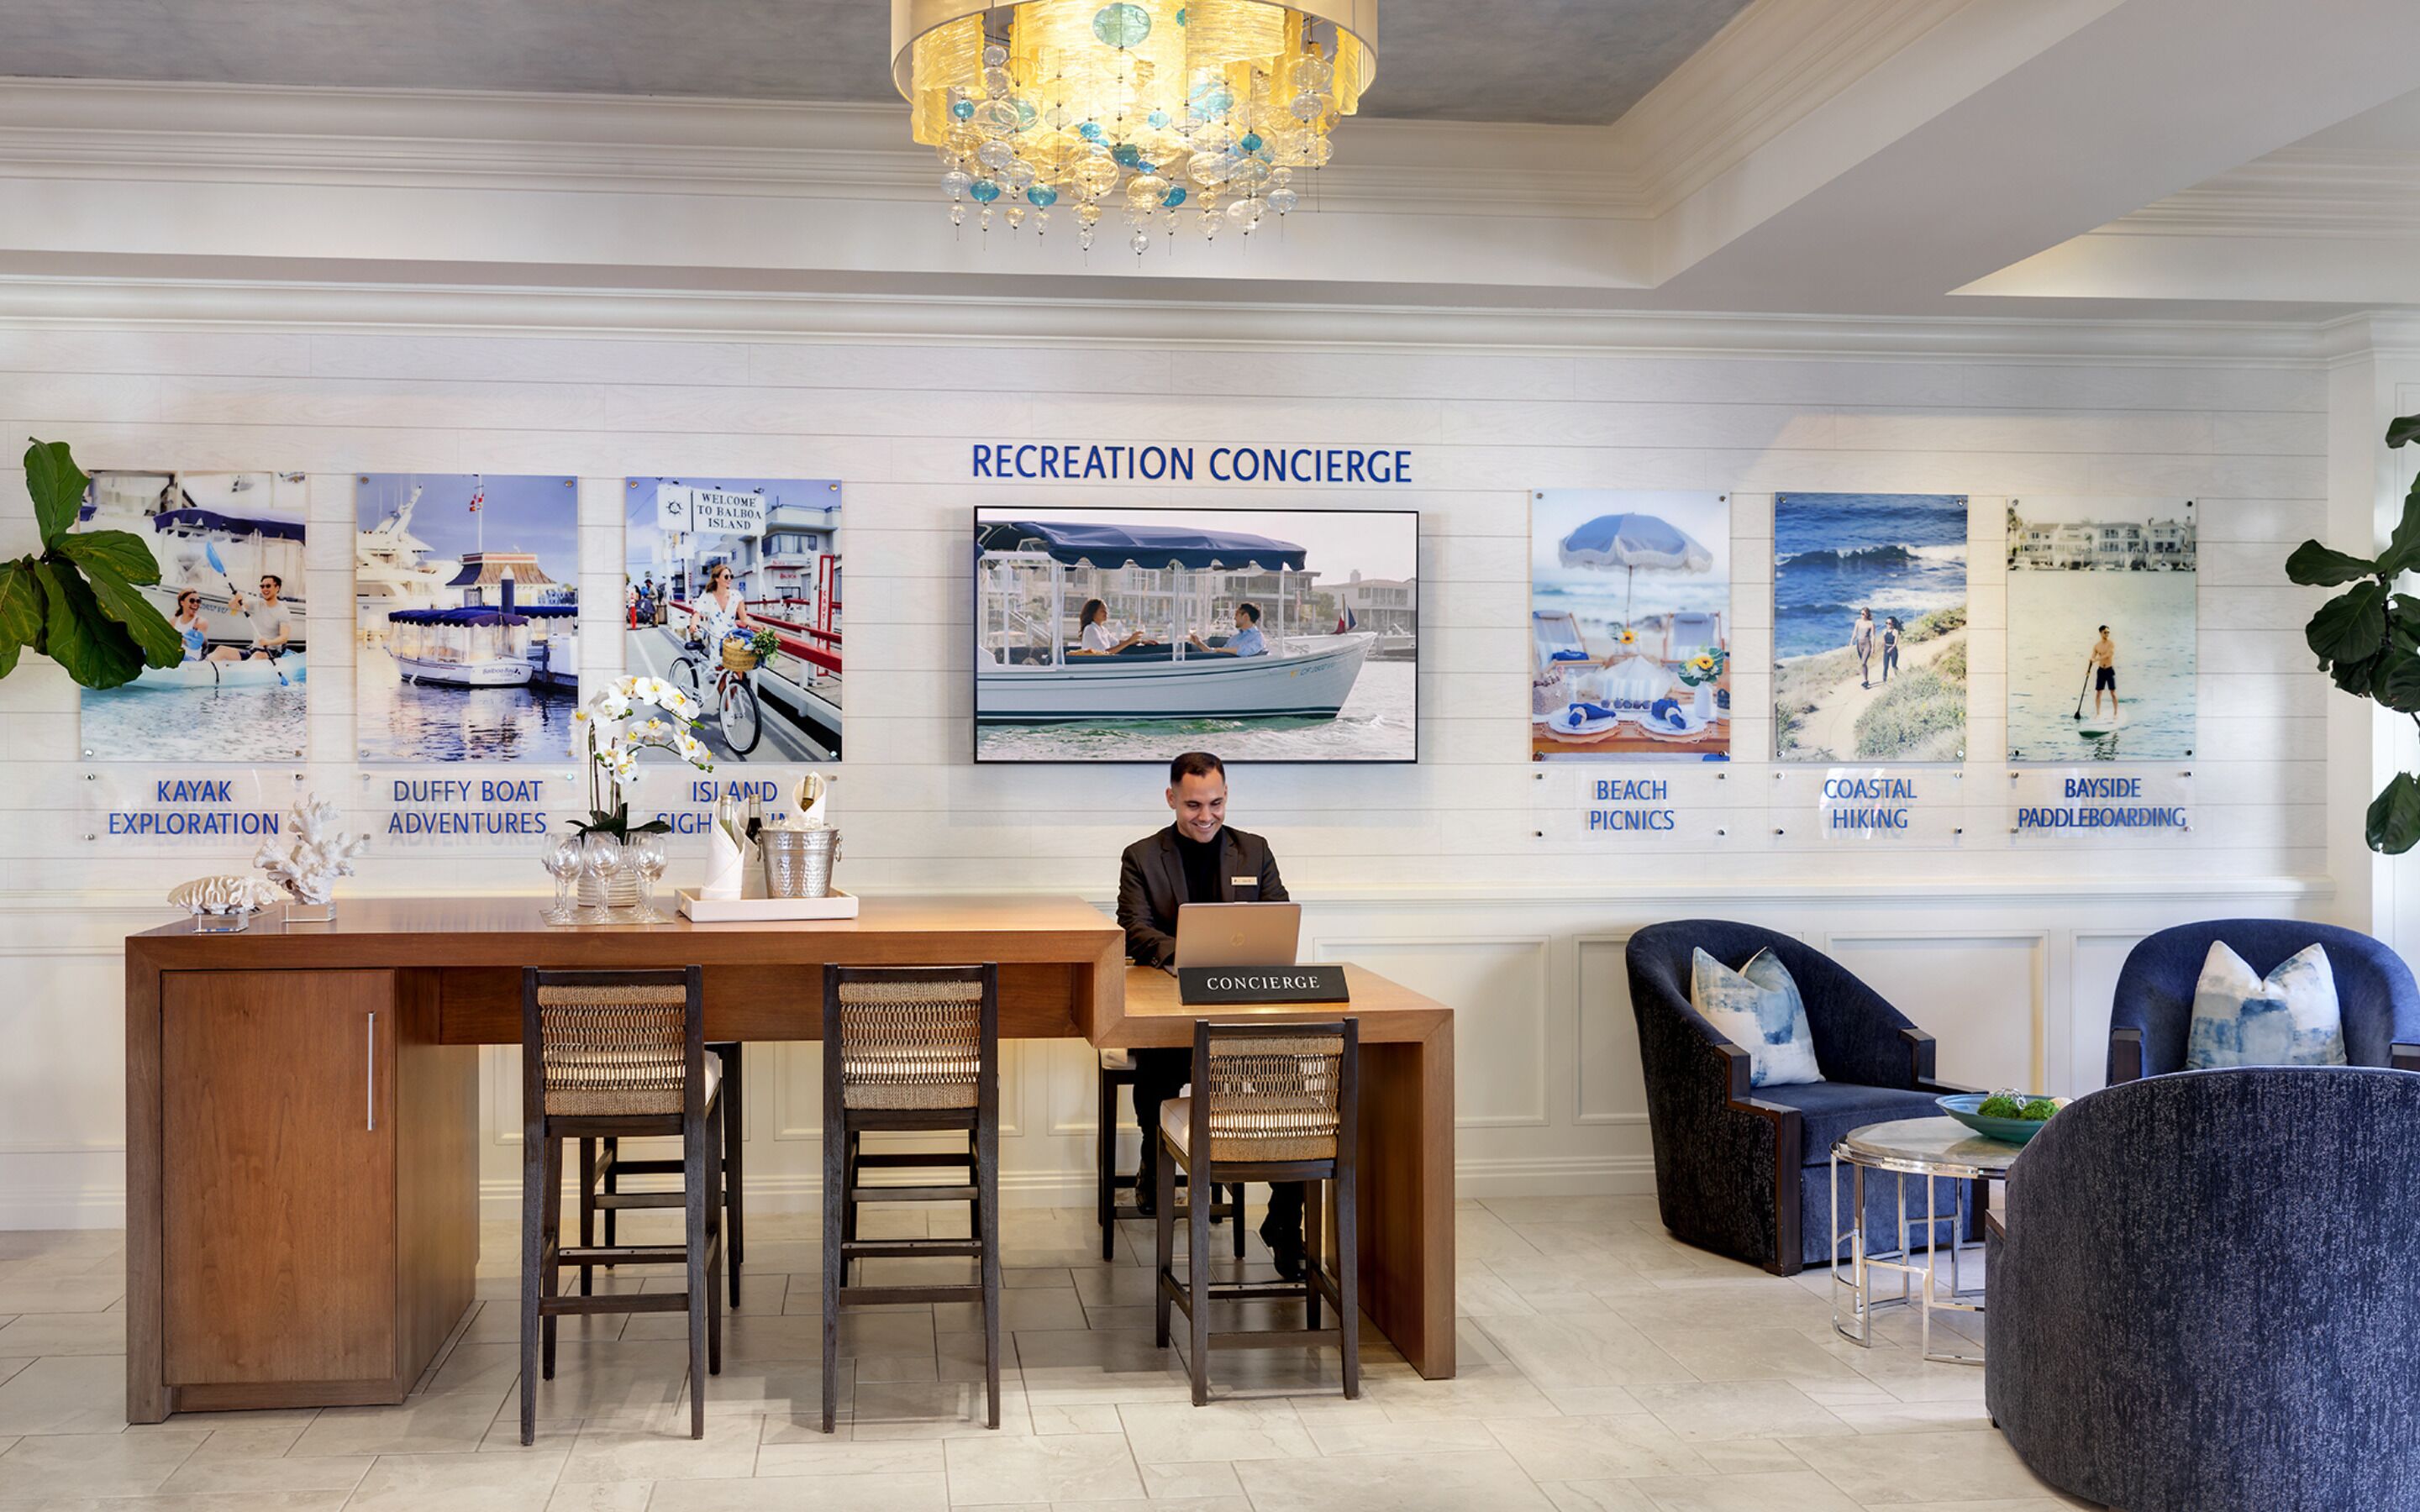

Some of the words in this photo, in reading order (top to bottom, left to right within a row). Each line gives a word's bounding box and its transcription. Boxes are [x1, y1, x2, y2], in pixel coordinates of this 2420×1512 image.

[973, 444, 1193, 480] RECREATION
[1210, 448, 1413, 483] CONCIERGE
[702, 493, 755, 507] WELCOME
[697, 505, 713, 515] TO
[717, 507, 762, 519] BALBOA
[708, 517, 751, 530] ISLAND
[157, 780, 232, 802] KAYAK
[394, 780, 471, 801] DUFFY
[481, 780, 544, 802] BOAT
[1597, 780, 1667, 801] BEACH
[1824, 779, 1918, 799] COASTAL
[2065, 778, 2142, 798] BAYSIDE
[108, 812, 279, 835] EXPLORATION
[387, 812, 547, 834] ADVENTURES
[1590, 810, 1675, 831] PICNICS
[1833, 808, 1908, 829] HIKING
[2018, 807, 2186, 828] PADDLEBOARDING
[1206, 976, 1321, 990] CONCIERGE
